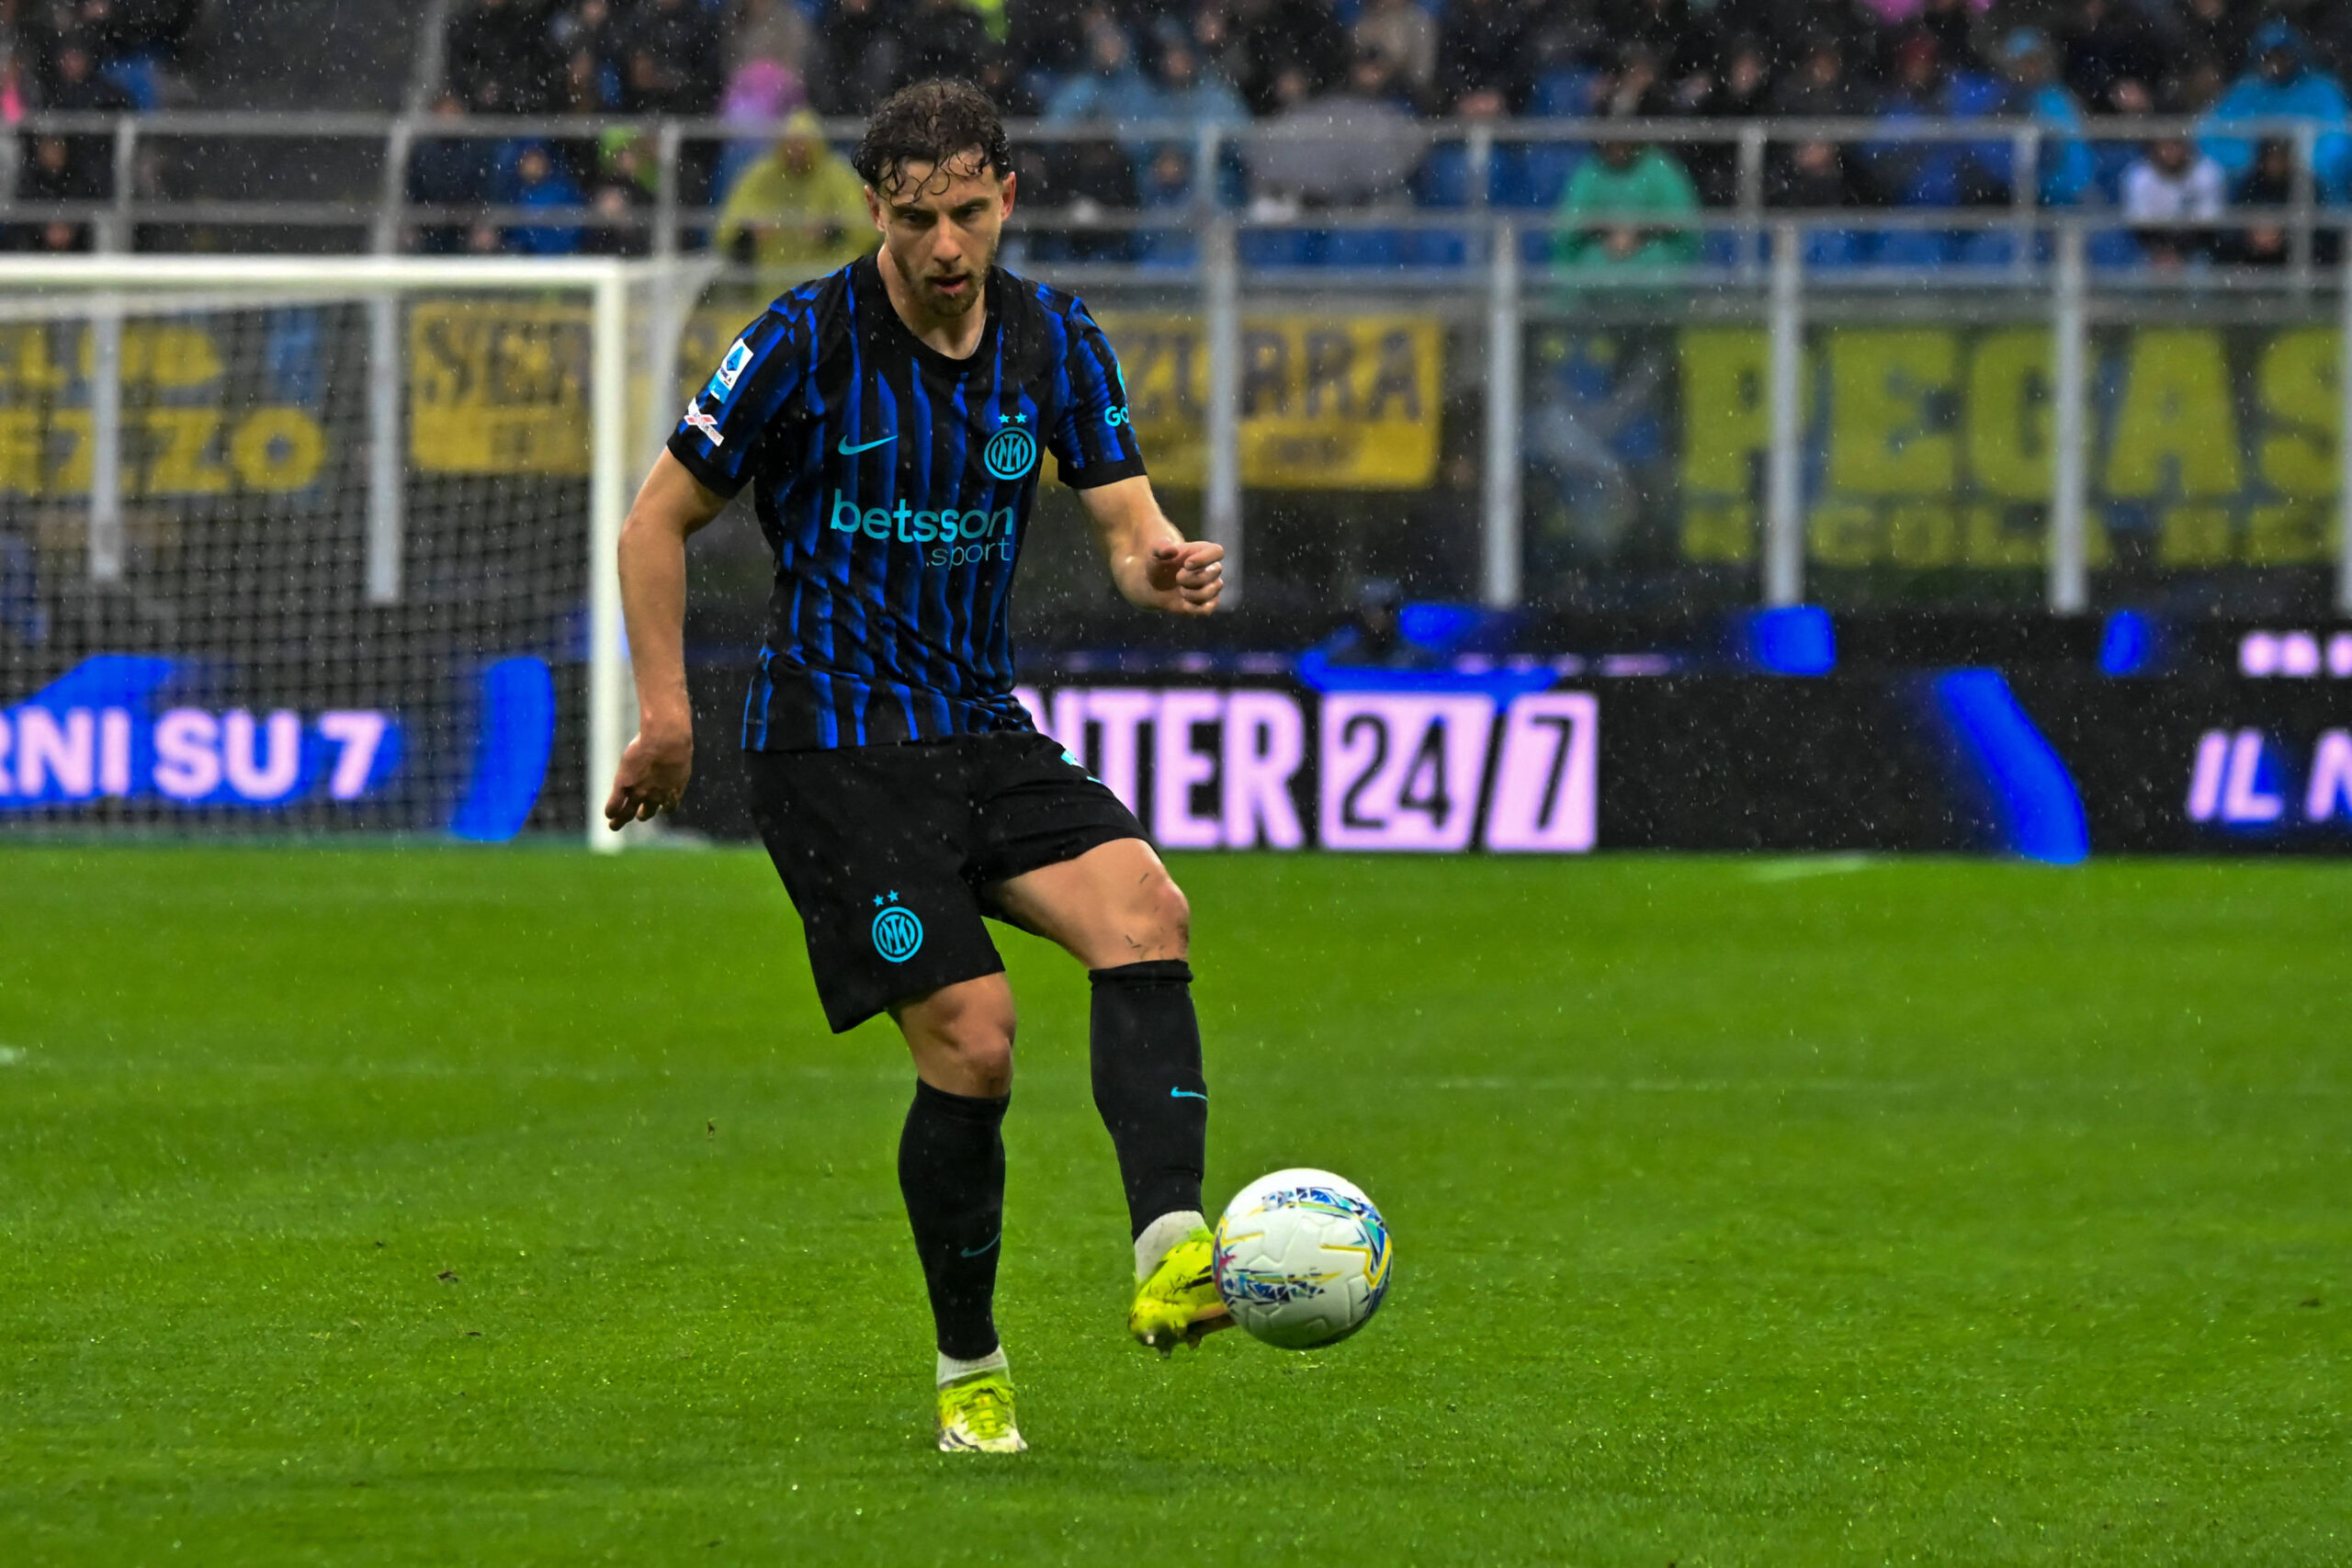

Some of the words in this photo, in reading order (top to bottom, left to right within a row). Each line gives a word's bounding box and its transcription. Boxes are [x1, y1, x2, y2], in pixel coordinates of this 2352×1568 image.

[831, 488, 1014, 543] betsson
[0, 706, 130, 796] NI
[154, 707, 300, 799] SU
[319, 711, 386, 799] 7
[2188, 730, 2282, 820] IL
